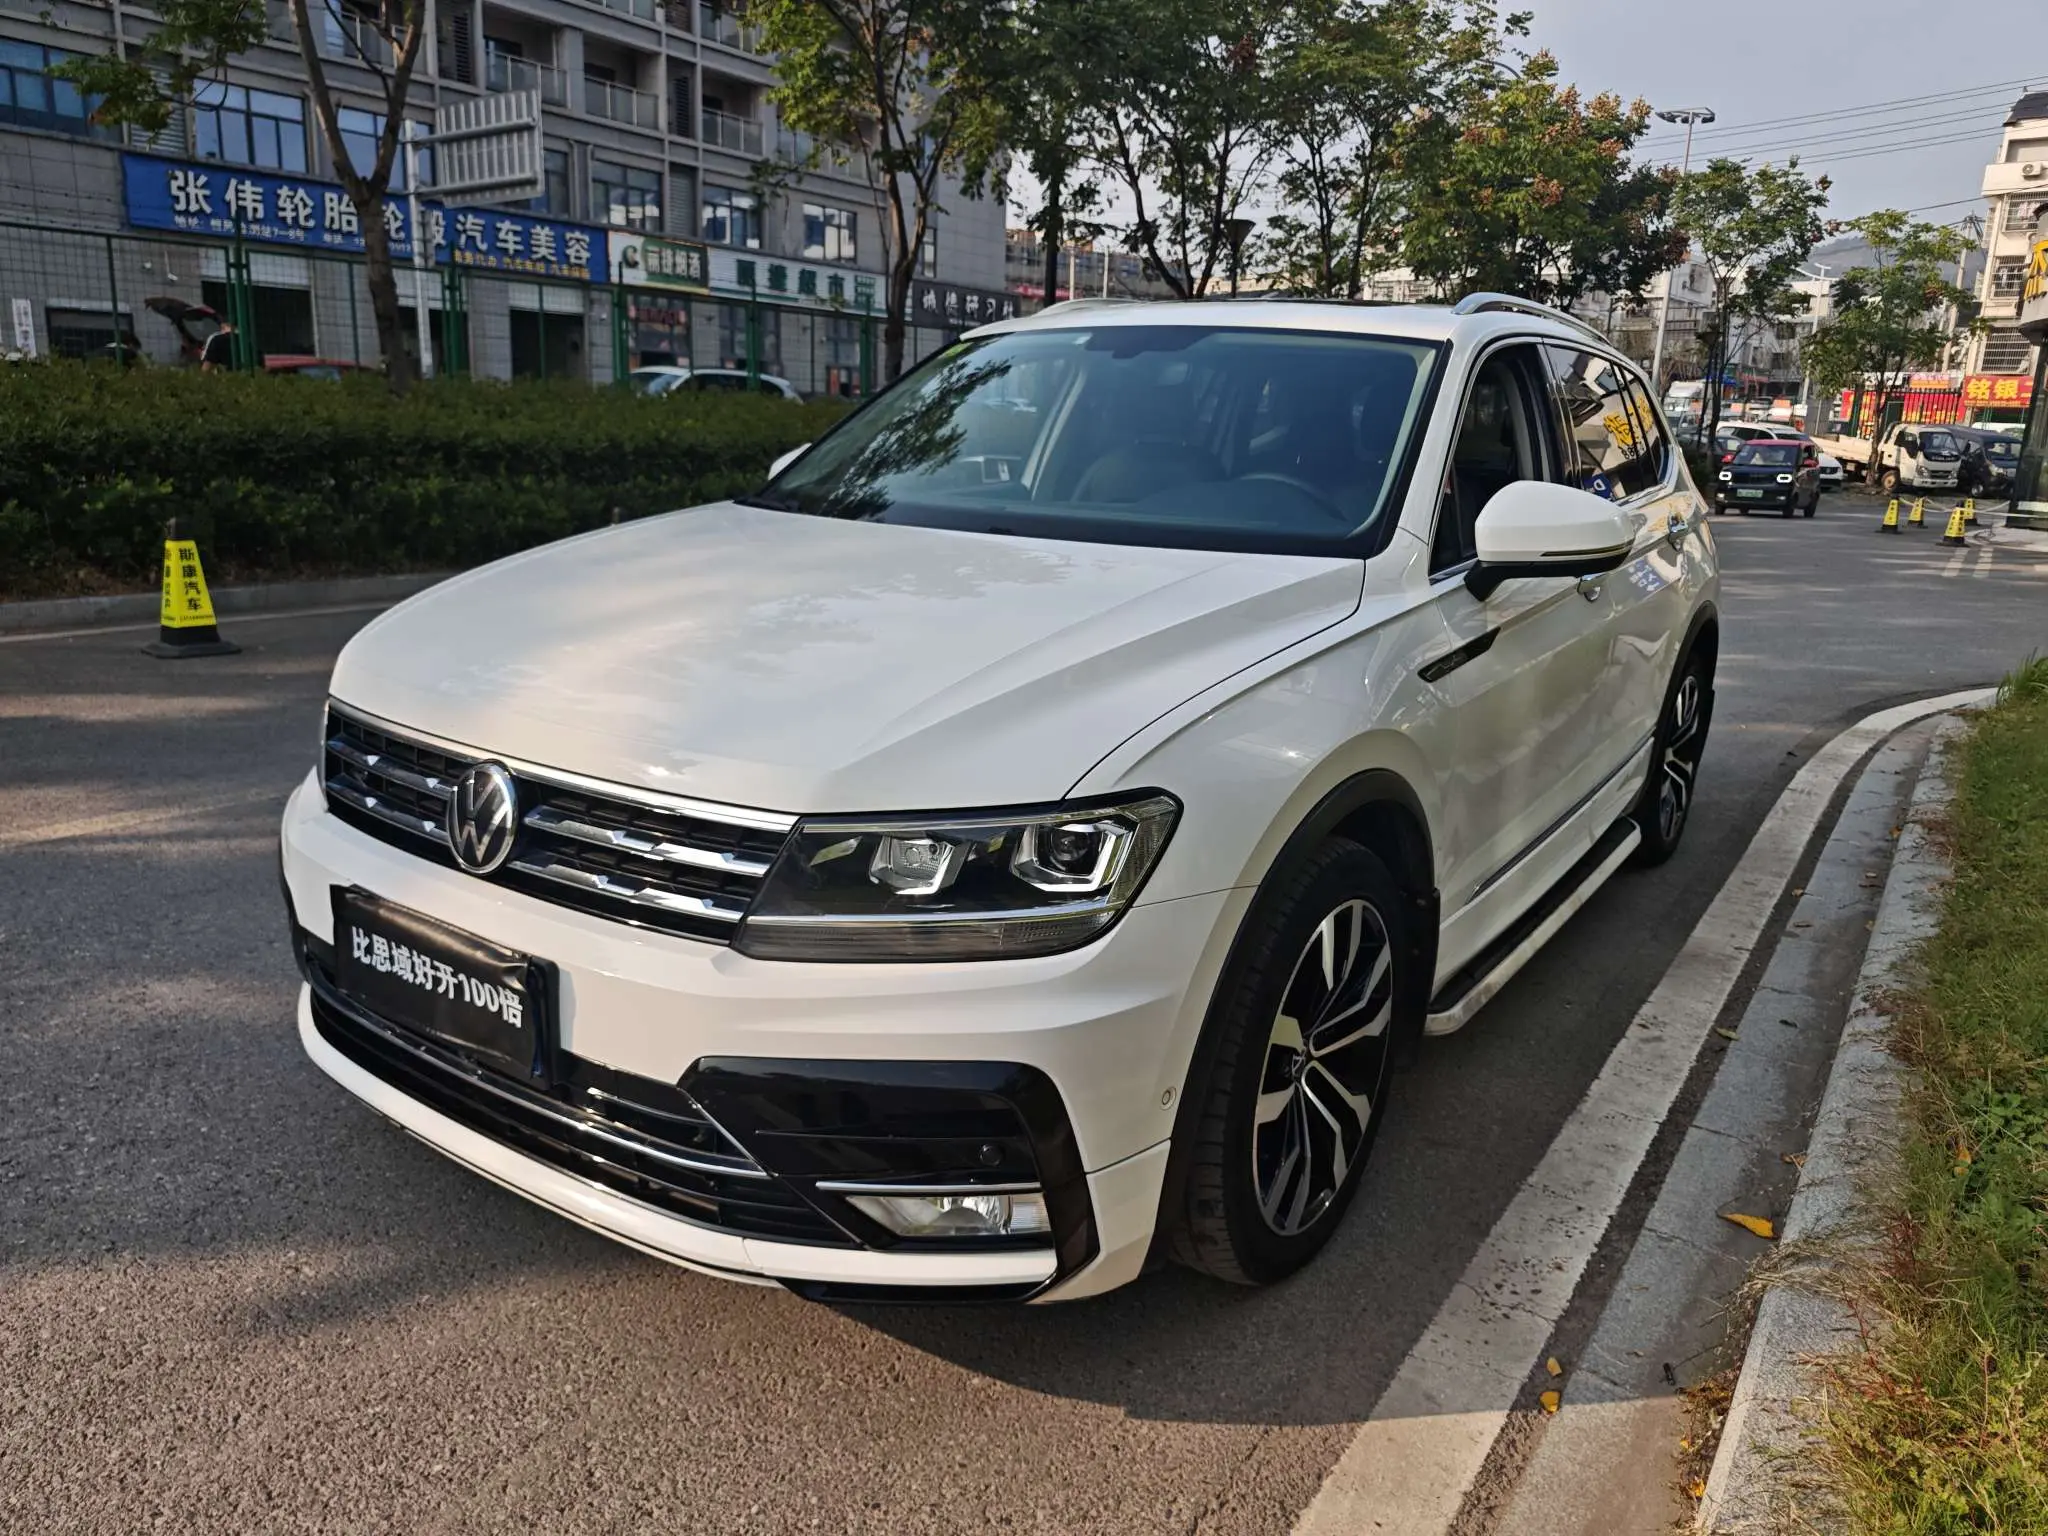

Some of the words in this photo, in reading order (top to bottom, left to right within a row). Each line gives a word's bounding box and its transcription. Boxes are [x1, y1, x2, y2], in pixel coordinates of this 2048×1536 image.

[352, 926, 523, 1028] 比思域好开100倍
